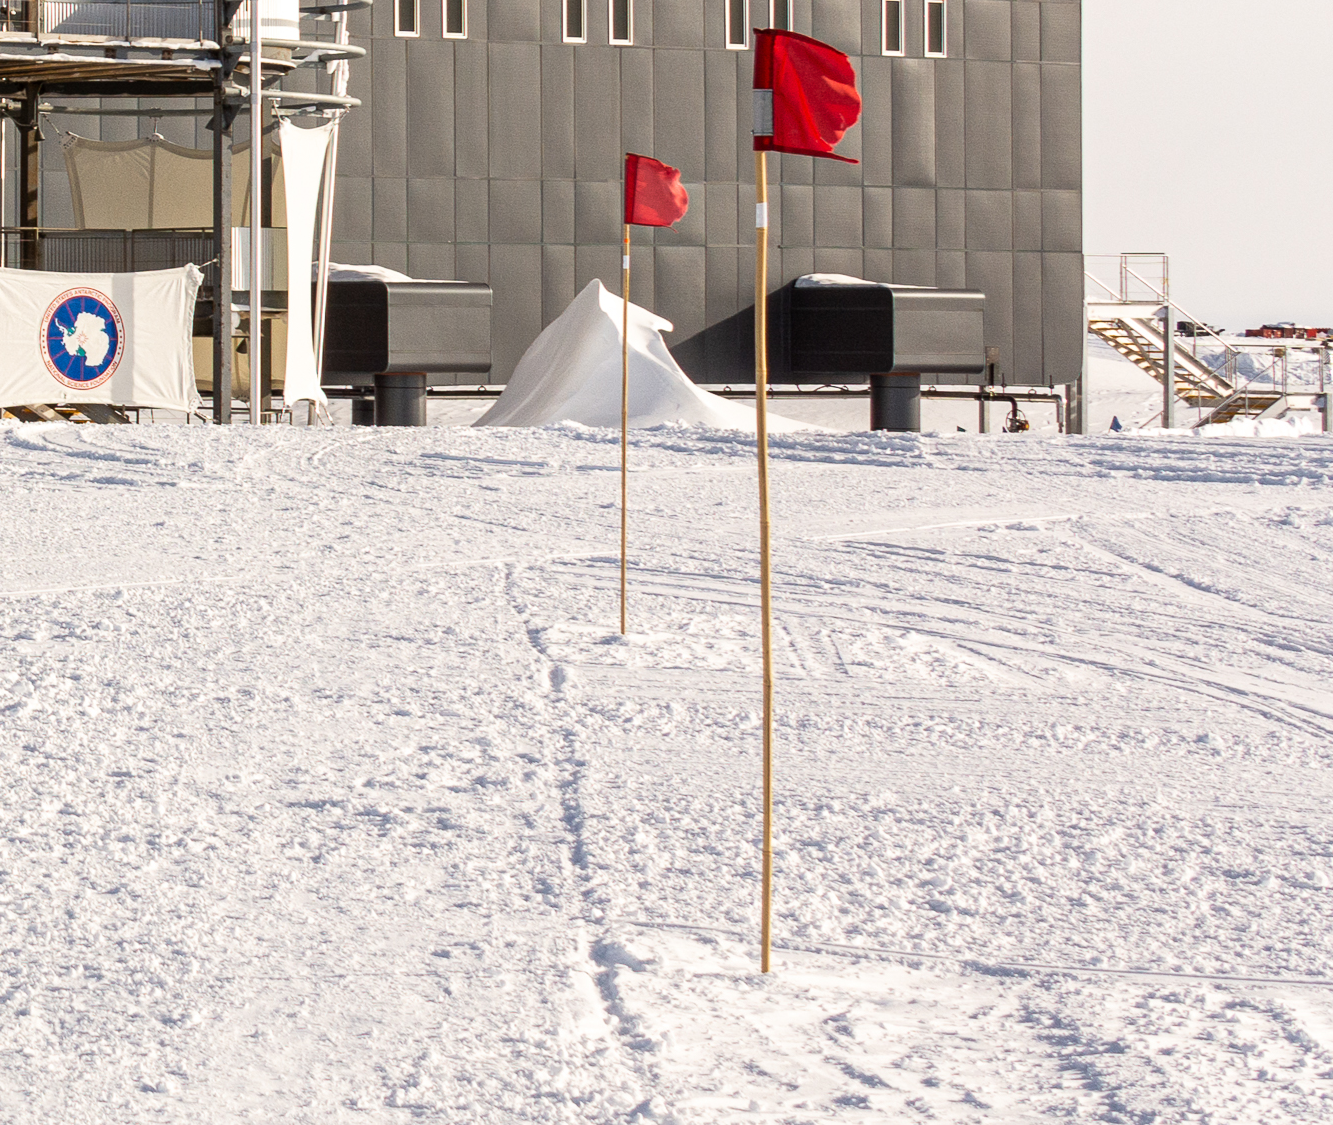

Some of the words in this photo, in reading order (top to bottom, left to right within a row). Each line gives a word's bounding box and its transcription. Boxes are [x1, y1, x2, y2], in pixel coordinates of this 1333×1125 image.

[44, 303, 57, 322] UNITED
[55, 291, 73, 305] STATES
[74, 289, 103, 300] ANTARCTIC
[102, 296, 121, 324] PROGRAM
[46, 360, 66, 383] NATIONAL
[67, 380, 90, 388] SCIENCE
[90, 361, 118, 386] FOUNDATION
